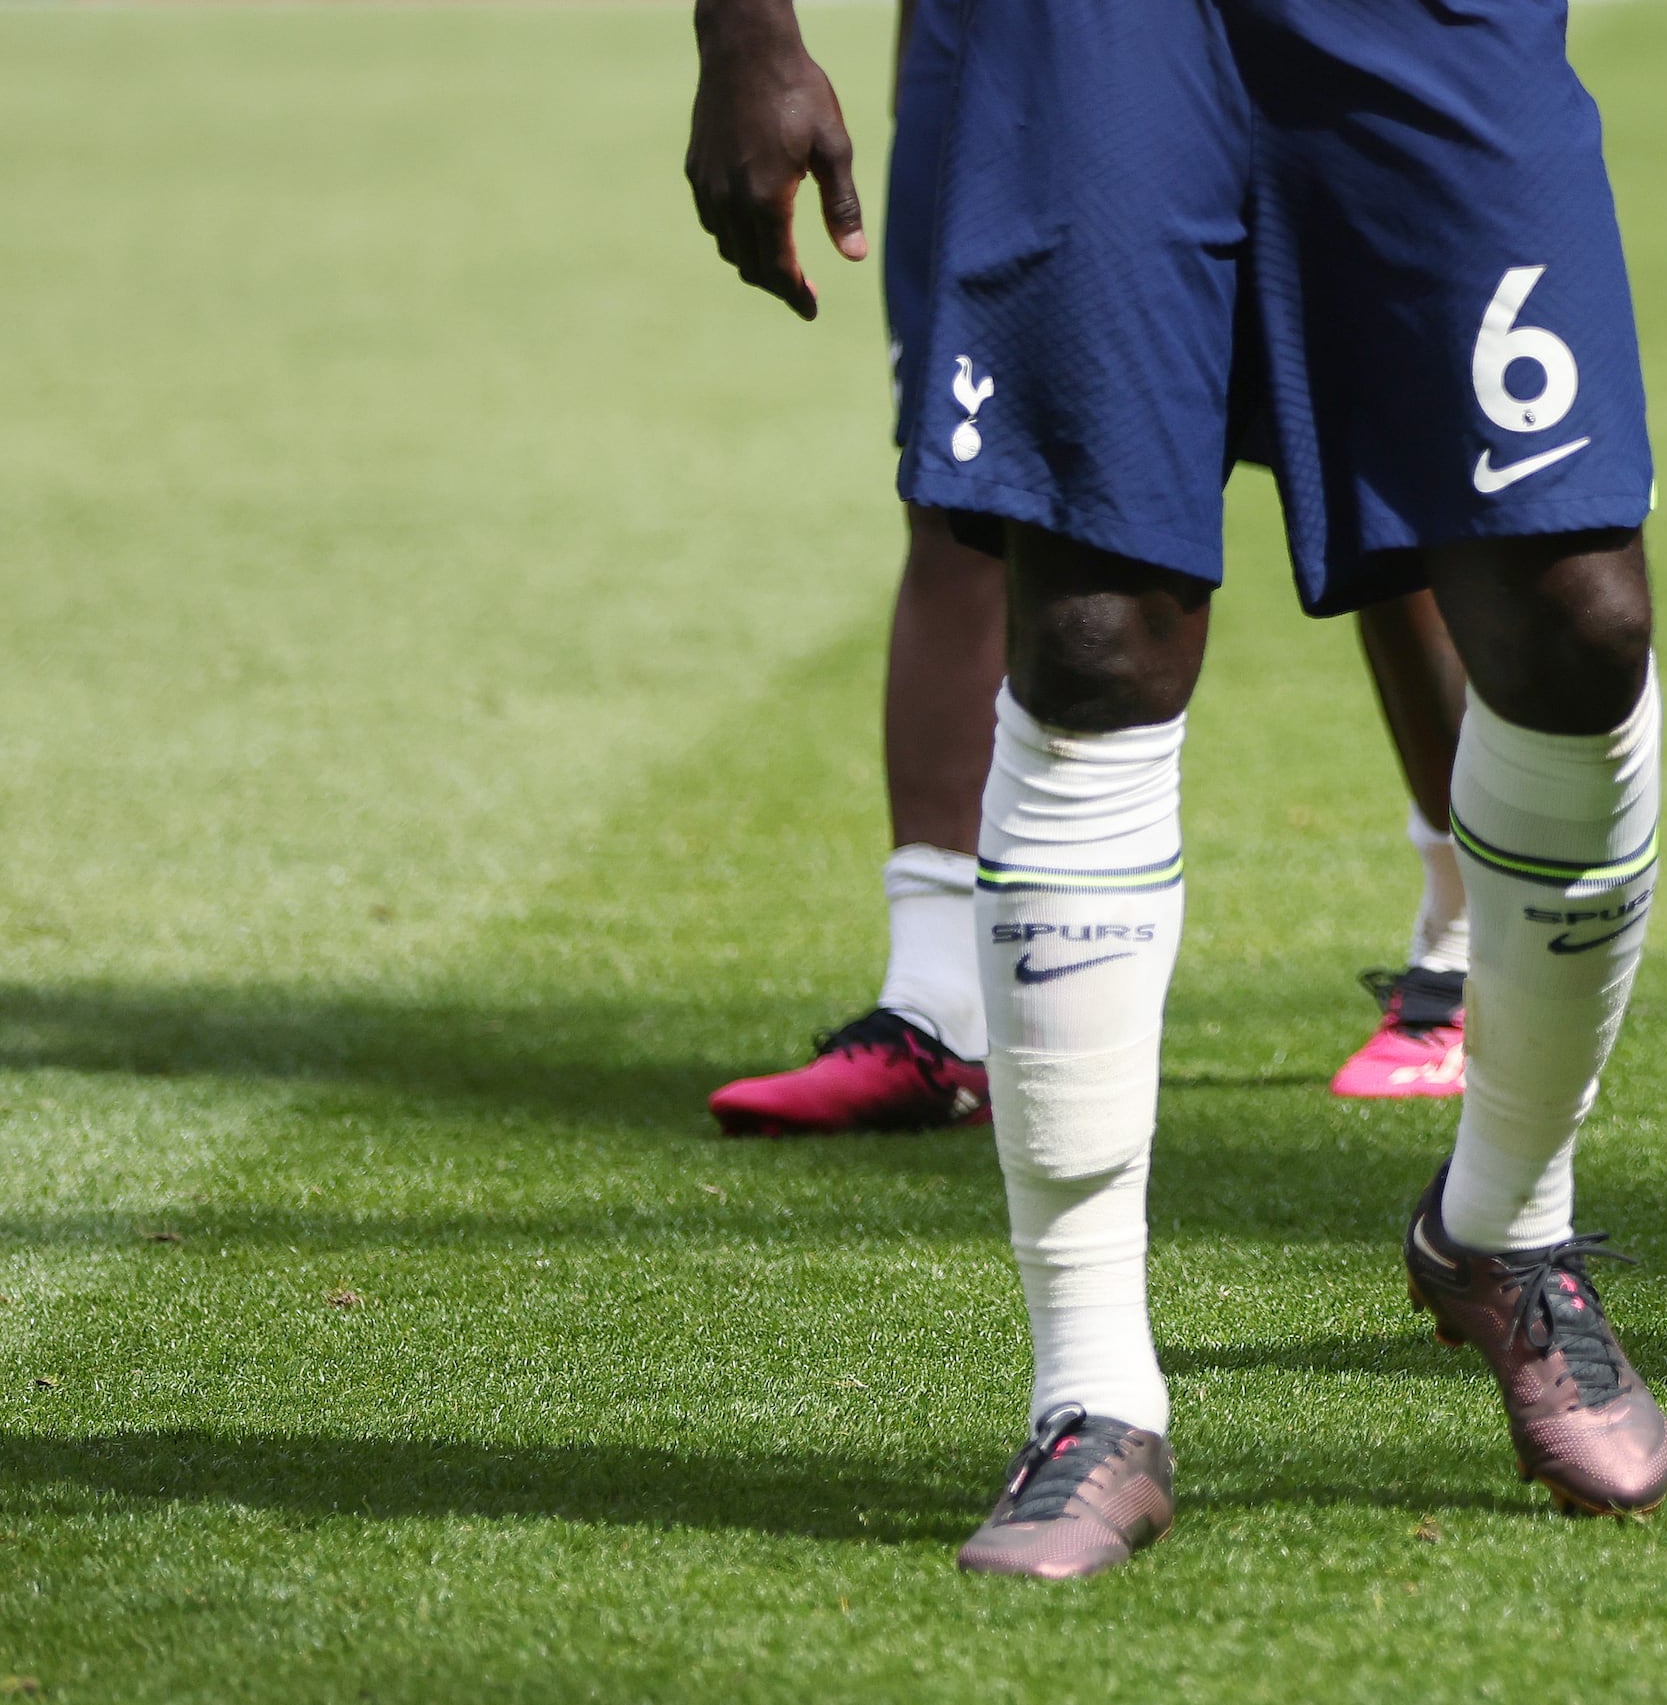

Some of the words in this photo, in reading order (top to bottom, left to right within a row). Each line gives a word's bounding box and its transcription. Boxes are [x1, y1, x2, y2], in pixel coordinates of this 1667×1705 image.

[1472, 264, 1579, 433] 6
[1524, 888, 1655, 925] SPUR
[991, 922, 1156, 944] SPURS
